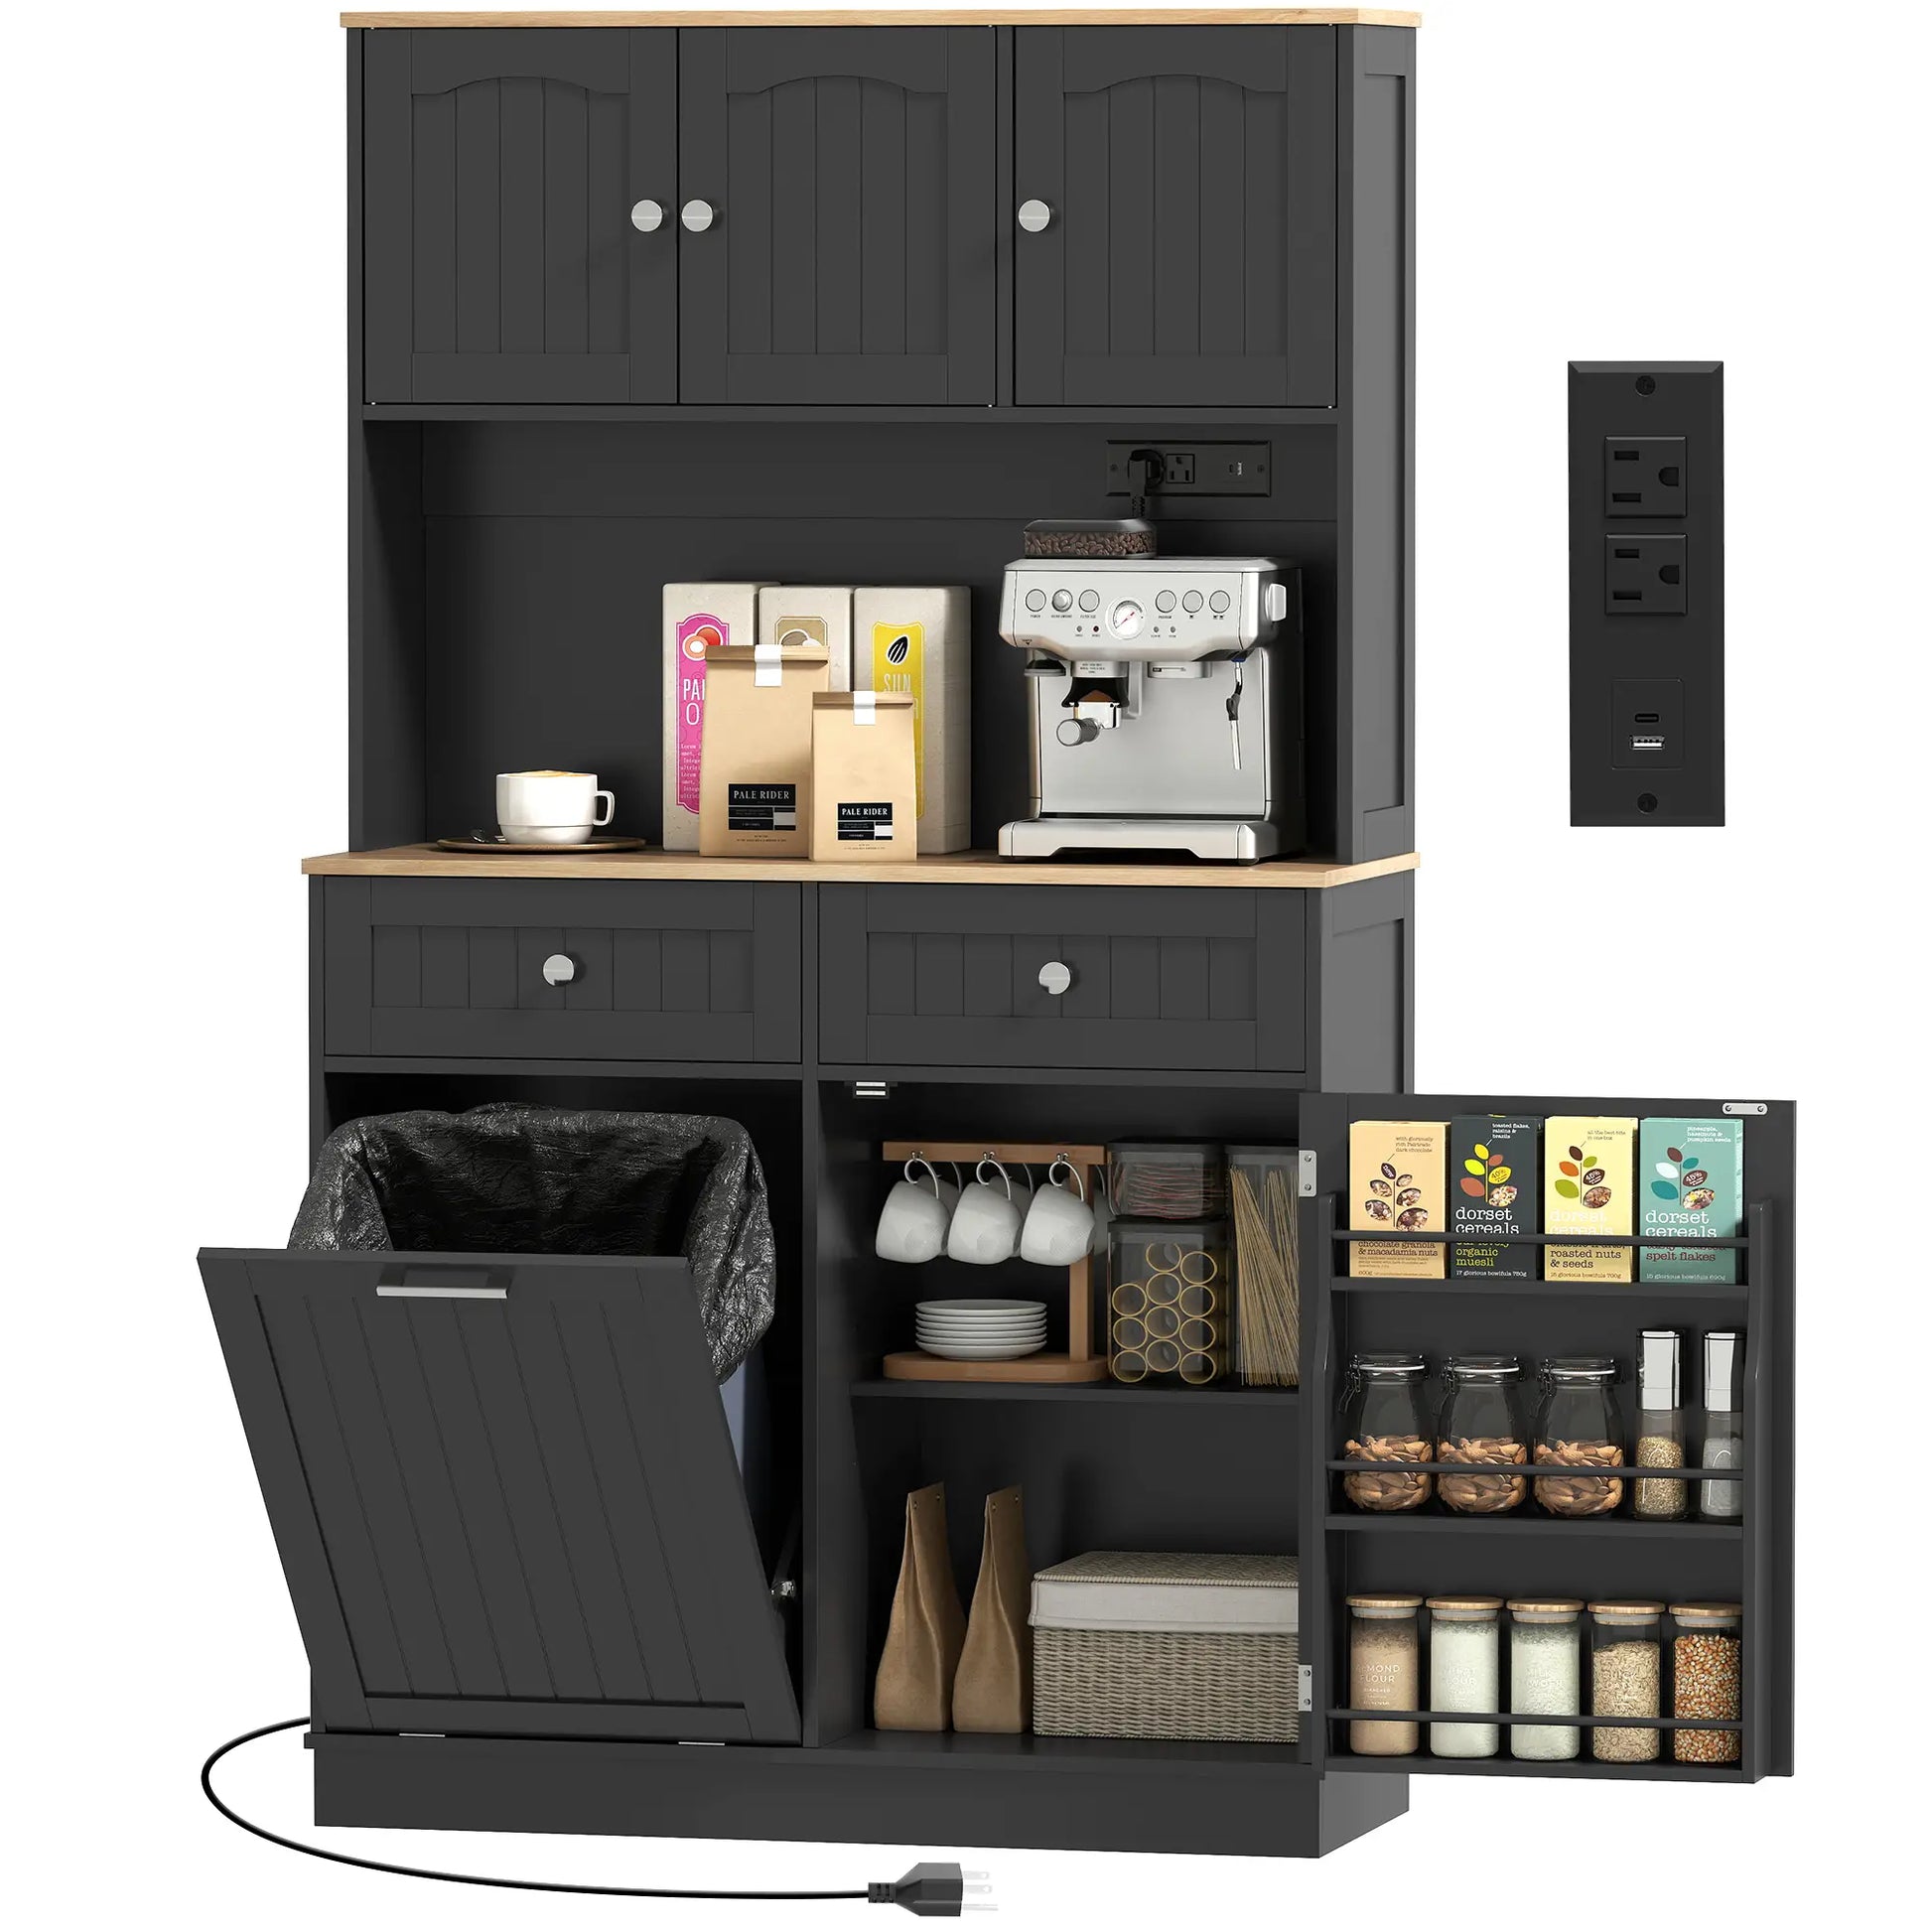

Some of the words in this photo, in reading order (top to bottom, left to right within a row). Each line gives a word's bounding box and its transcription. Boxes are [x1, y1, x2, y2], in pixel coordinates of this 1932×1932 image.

[734, 790, 757, 799] PALE
[759, 790, 789, 799] RIDER
[841, 807, 862, 816] PALE
[1455, 1206, 1513, 1221] dorset
[1550, 1209, 1607, 1223] dorset
[1645, 1209, 1710, 1224] dorset
[1455, 1222, 1520, 1234] cereals
[1645, 1226, 1718, 1238] cereals
[1455, 1247, 1499, 1258] organic
[1550, 1249, 1593, 1258] roasted
[1595, 1250, 1622, 1259] nuts
[1646, 1251, 1678, 1263] spelt
[1679, 1251, 1717, 1262] flakes
[1455, 1257, 1495, 1267] muesli
[1550, 1258, 1561, 1269] &
[1562, 1259, 1594, 1269] seeds
[1356, 1664, 1401, 1673] MOND
